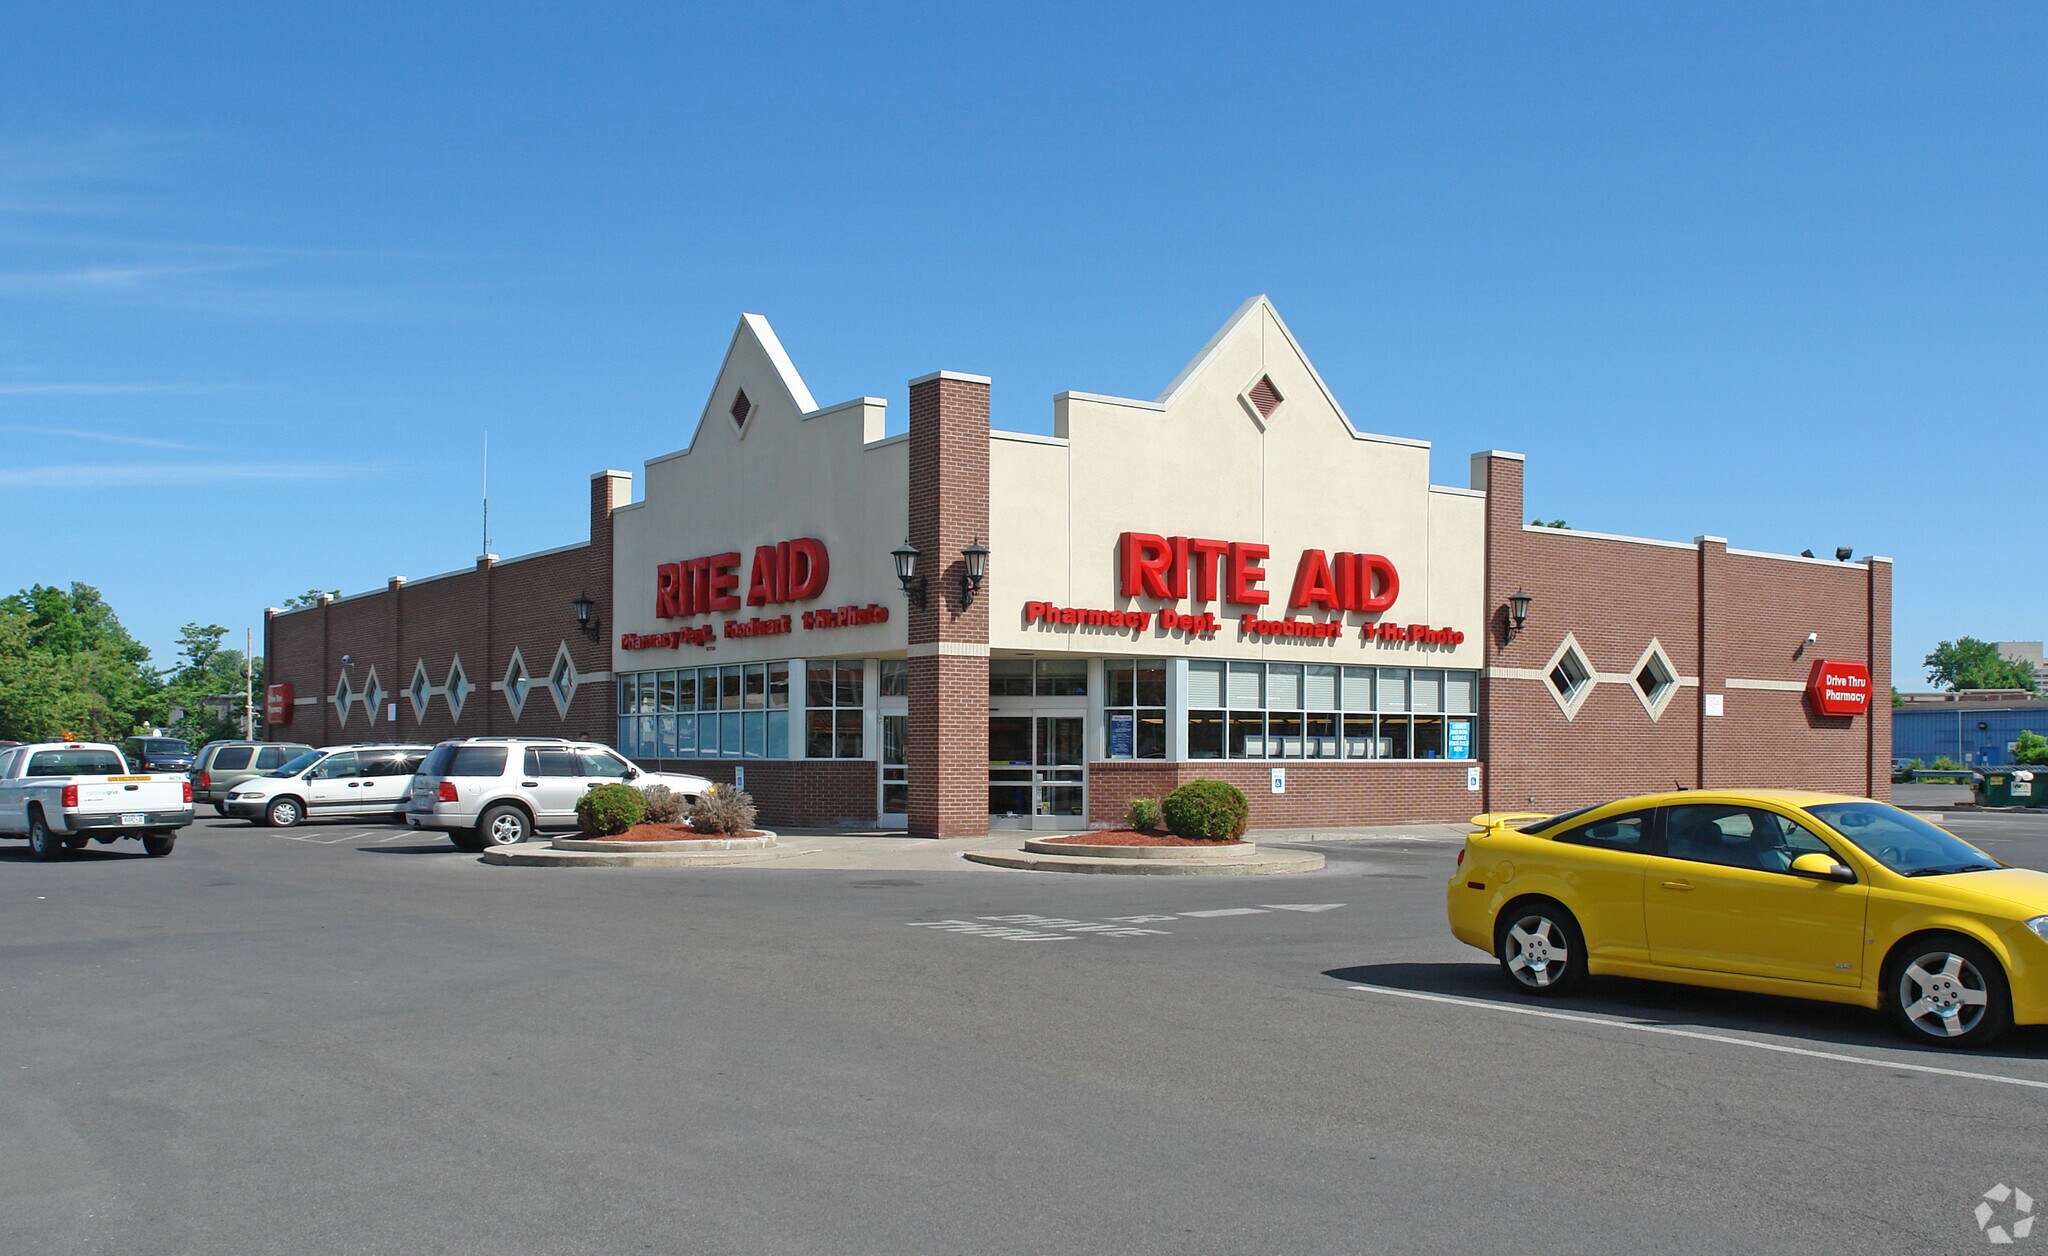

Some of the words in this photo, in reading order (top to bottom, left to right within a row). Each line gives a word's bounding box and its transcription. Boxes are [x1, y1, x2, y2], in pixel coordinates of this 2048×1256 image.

[655, 552, 741, 618] RITE
[747, 537, 829, 606] AID
[1120, 532, 1270, 605] RITE
[1288, 549, 1400, 613] AID
[1026, 601, 1151, 631] Pharmacy
[1159, 608, 1222, 635] Dept.
[1241, 614, 1342, 638] Foodmart
[1409, 624, 1465, 645] Photo
[621, 633, 680, 650] Pharmacy
[1826, 674, 1846, 686] Drive
[1847, 676, 1866, 687] Thru
[1825, 689, 1866, 704] Pharmacy
